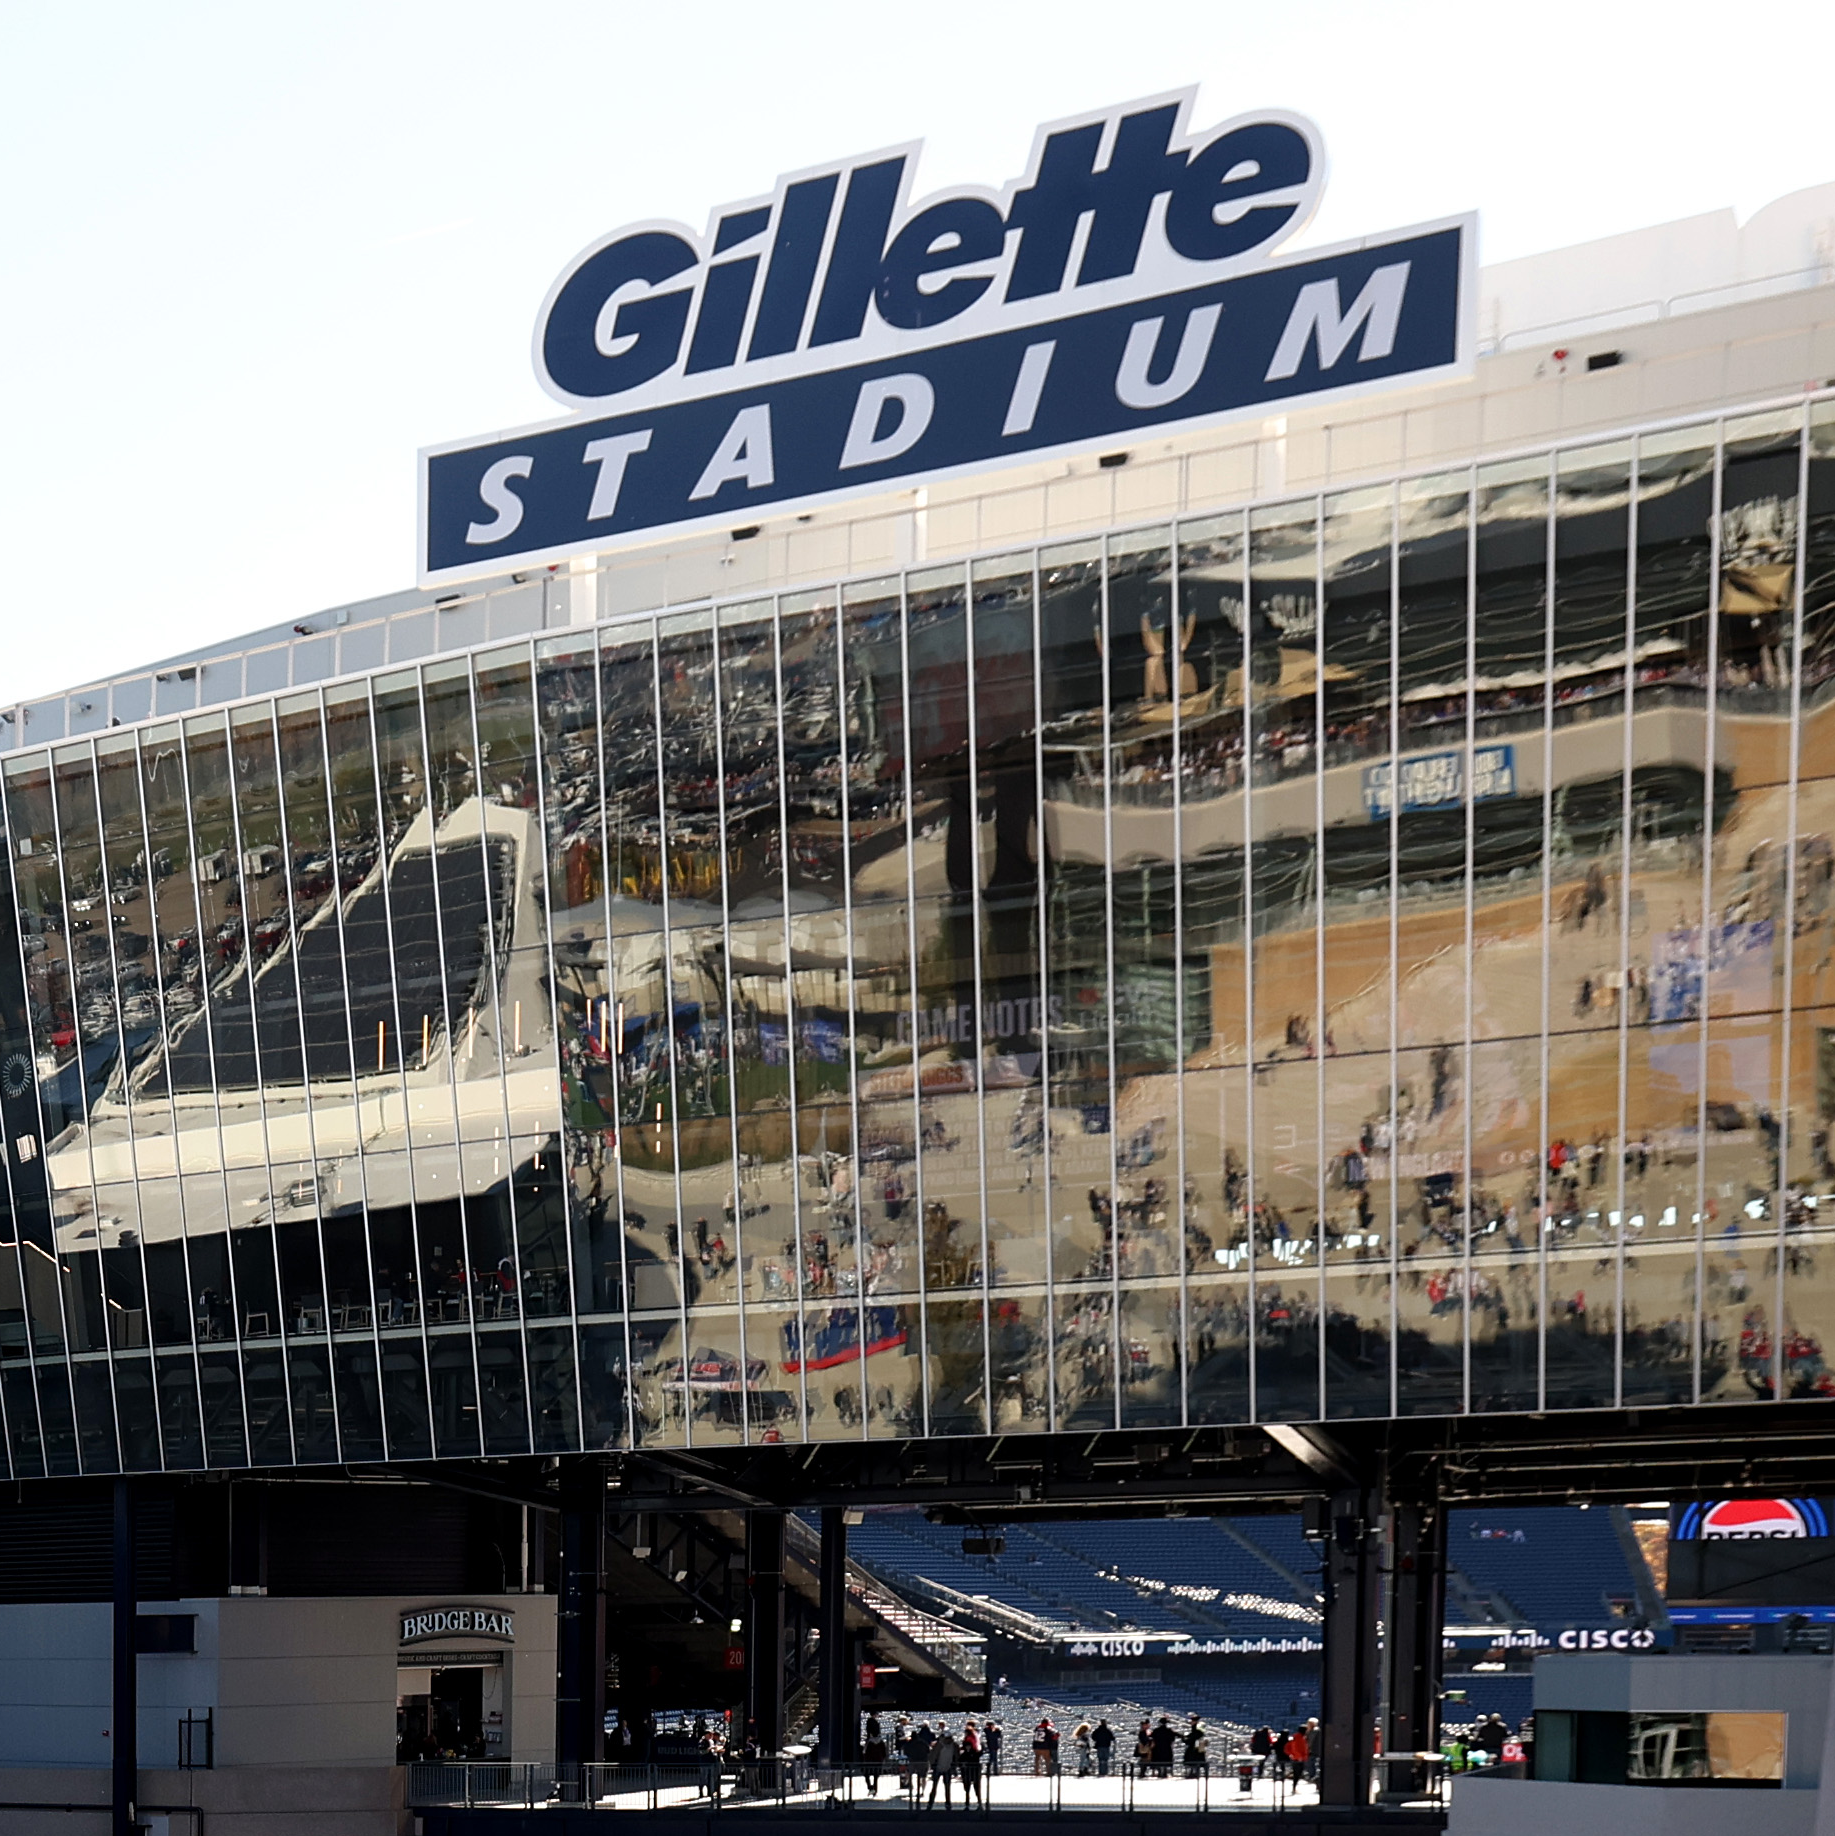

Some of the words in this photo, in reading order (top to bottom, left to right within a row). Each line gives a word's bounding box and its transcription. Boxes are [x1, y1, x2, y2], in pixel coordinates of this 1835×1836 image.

[542, 102, 1313, 400] Gillette
[466, 262, 1412, 546] STADIUM
[403, 1611, 470, 1639] BRIDGE
[474, 1611, 515, 1636] BAR
[1558, 1629, 1656, 1649] CISCO
[1101, 1639, 1144, 1657] CISCO
